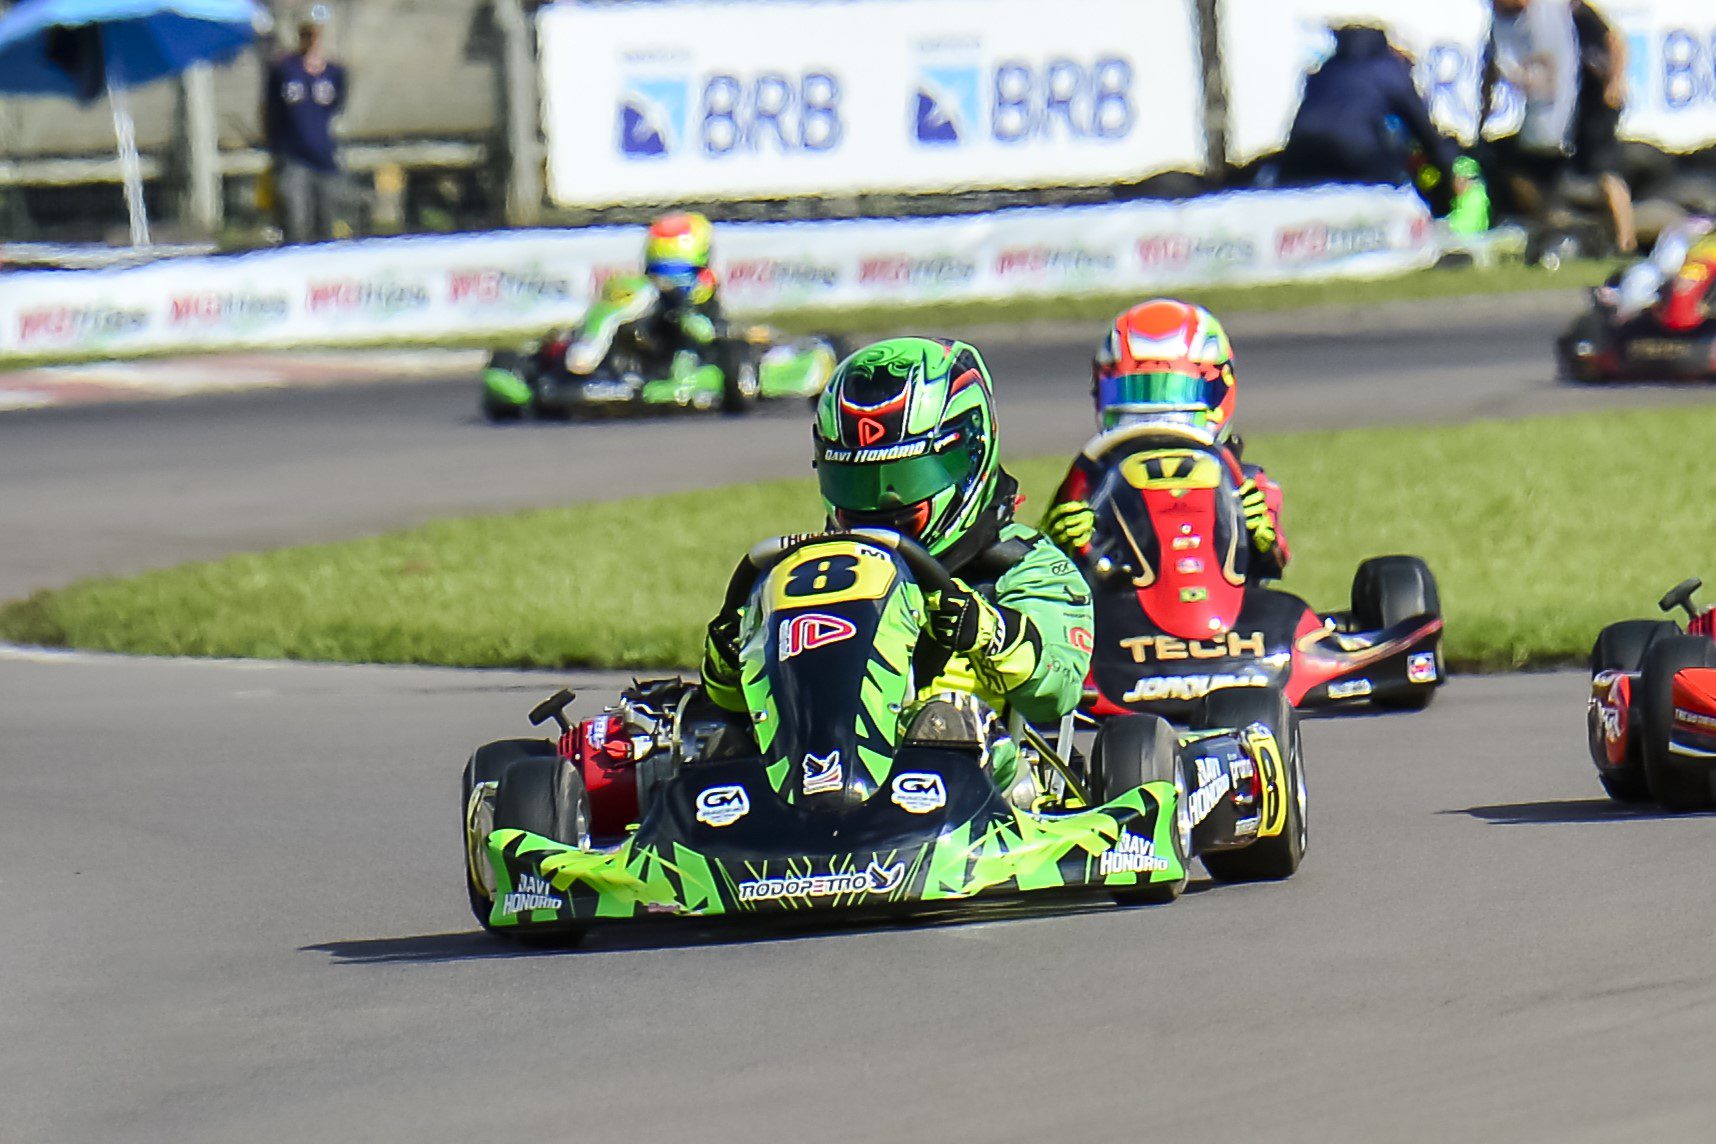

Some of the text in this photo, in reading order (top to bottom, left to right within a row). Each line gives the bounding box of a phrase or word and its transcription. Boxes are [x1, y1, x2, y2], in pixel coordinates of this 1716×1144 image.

[1662, 28, 1716, 109] B
[702, 72, 844, 153] BRB
[990, 56, 1134, 141] BRB
[784, 554, 859, 597] 8
[1119, 631, 1266, 664] TECH
[704, 788, 744, 808] GM
[899, 777, 940, 797] GM
[1118, 832, 1156, 857] DAVI
[741, 876, 867, 899] RODOPETRO
